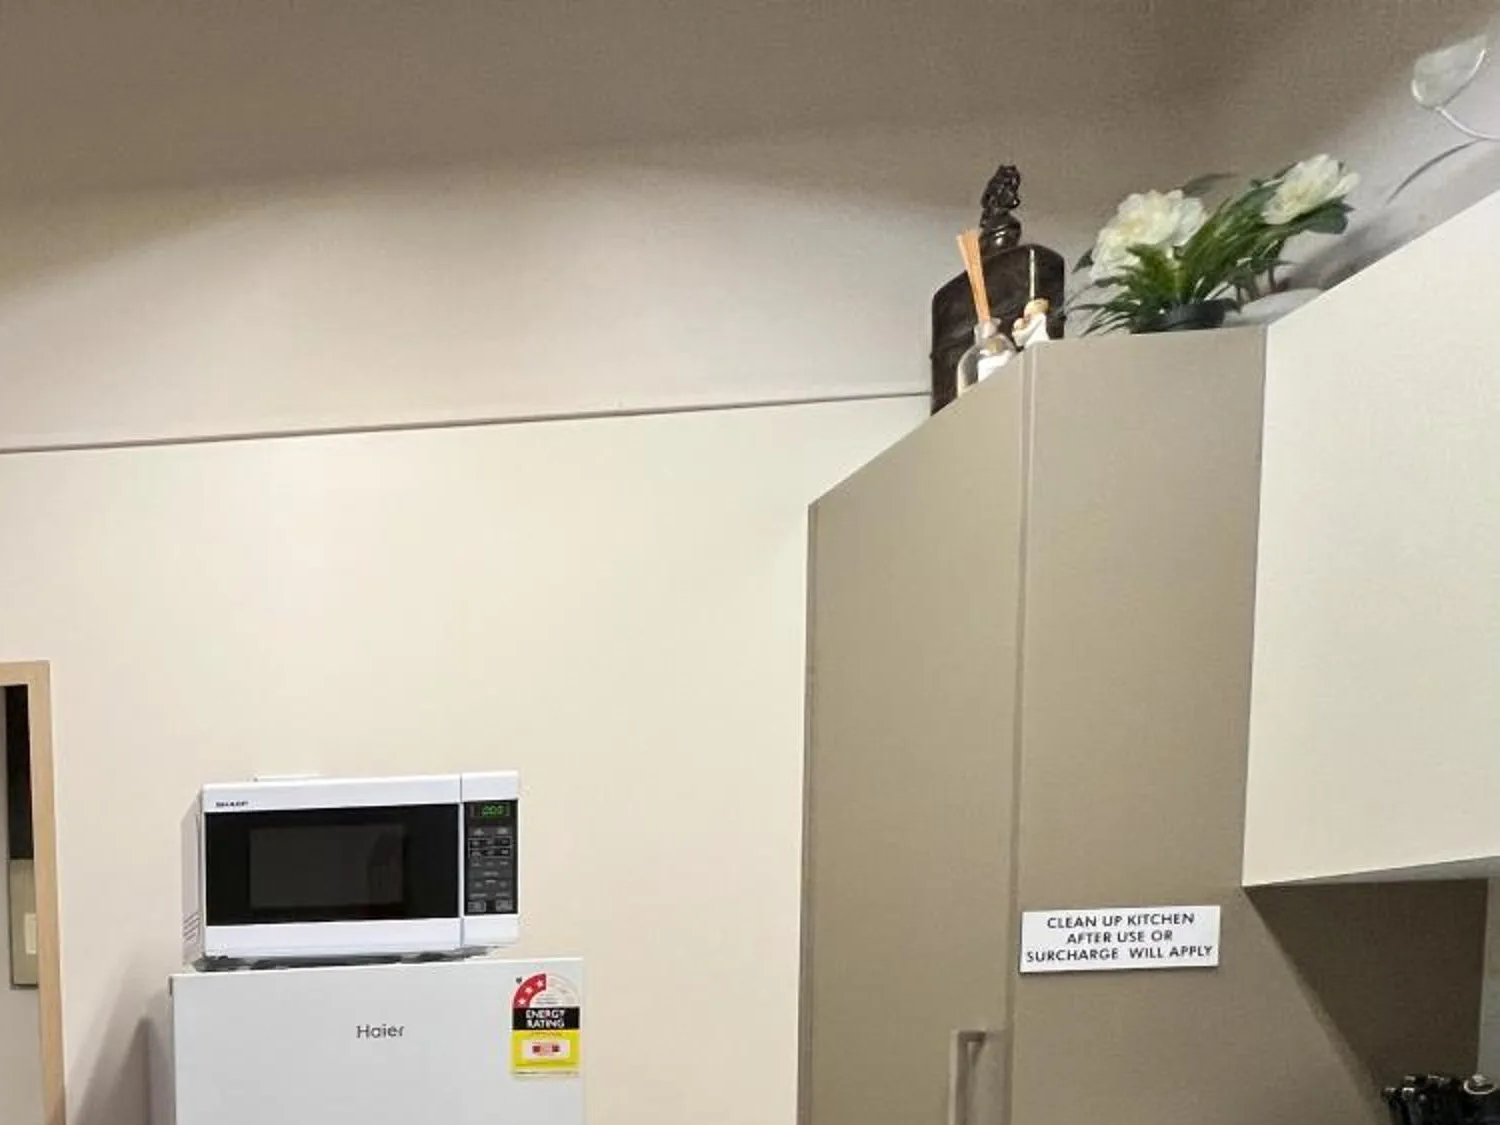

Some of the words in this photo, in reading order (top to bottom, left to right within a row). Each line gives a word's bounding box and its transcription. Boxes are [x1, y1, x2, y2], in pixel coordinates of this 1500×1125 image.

[1046, 917, 1097, 929] CLEAN
[1101, 915, 1123, 927] UP
[1127, 913, 1195, 926] KITCHEN
[1066, 931, 1112, 944] AFTER
[1117, 931, 1145, 943] USE
[1151, 930, 1173, 942] OR
[1026, 947, 1119, 963] SURCHARGE
[1128, 947, 1164, 960] WILL
[1168, 945, 1213, 958] APPLY
[525, 1008, 565, 1019] ENERGY
[356, 1023, 405, 1039] Haier
[526, 1019, 565, 1029] RATING
